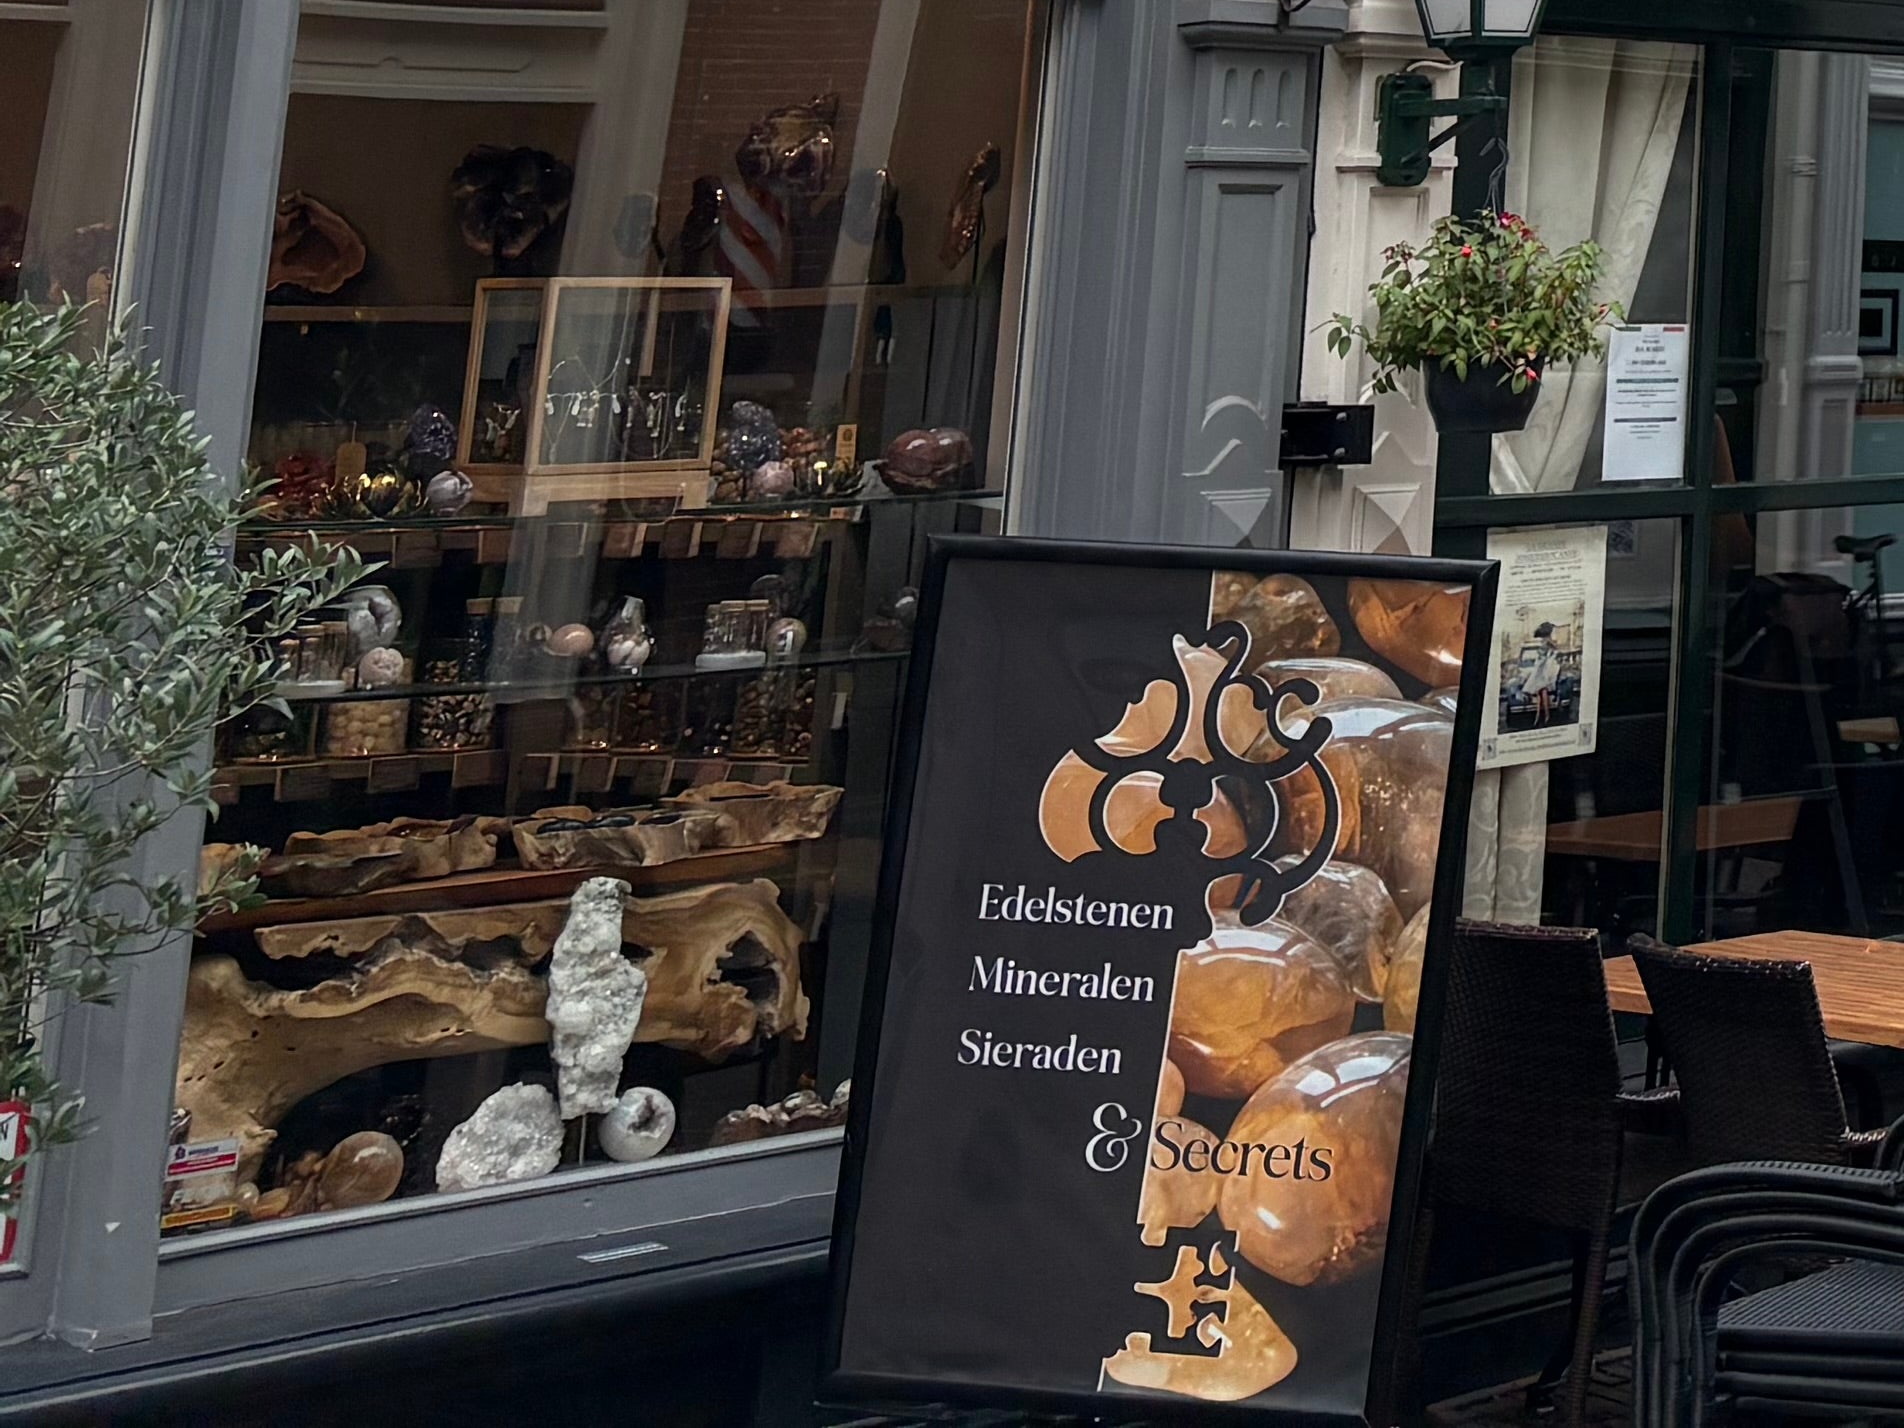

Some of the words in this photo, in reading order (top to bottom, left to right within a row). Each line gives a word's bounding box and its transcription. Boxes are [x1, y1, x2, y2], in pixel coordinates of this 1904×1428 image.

[978, 883, 1174, 930] Edelstenen
[968, 955, 1154, 1002] Mineralen
[957, 1028, 1122, 1074] Sieraden
[1085, 1102, 1142, 1172] &
[1150, 1120, 1334, 1182] Secrets
